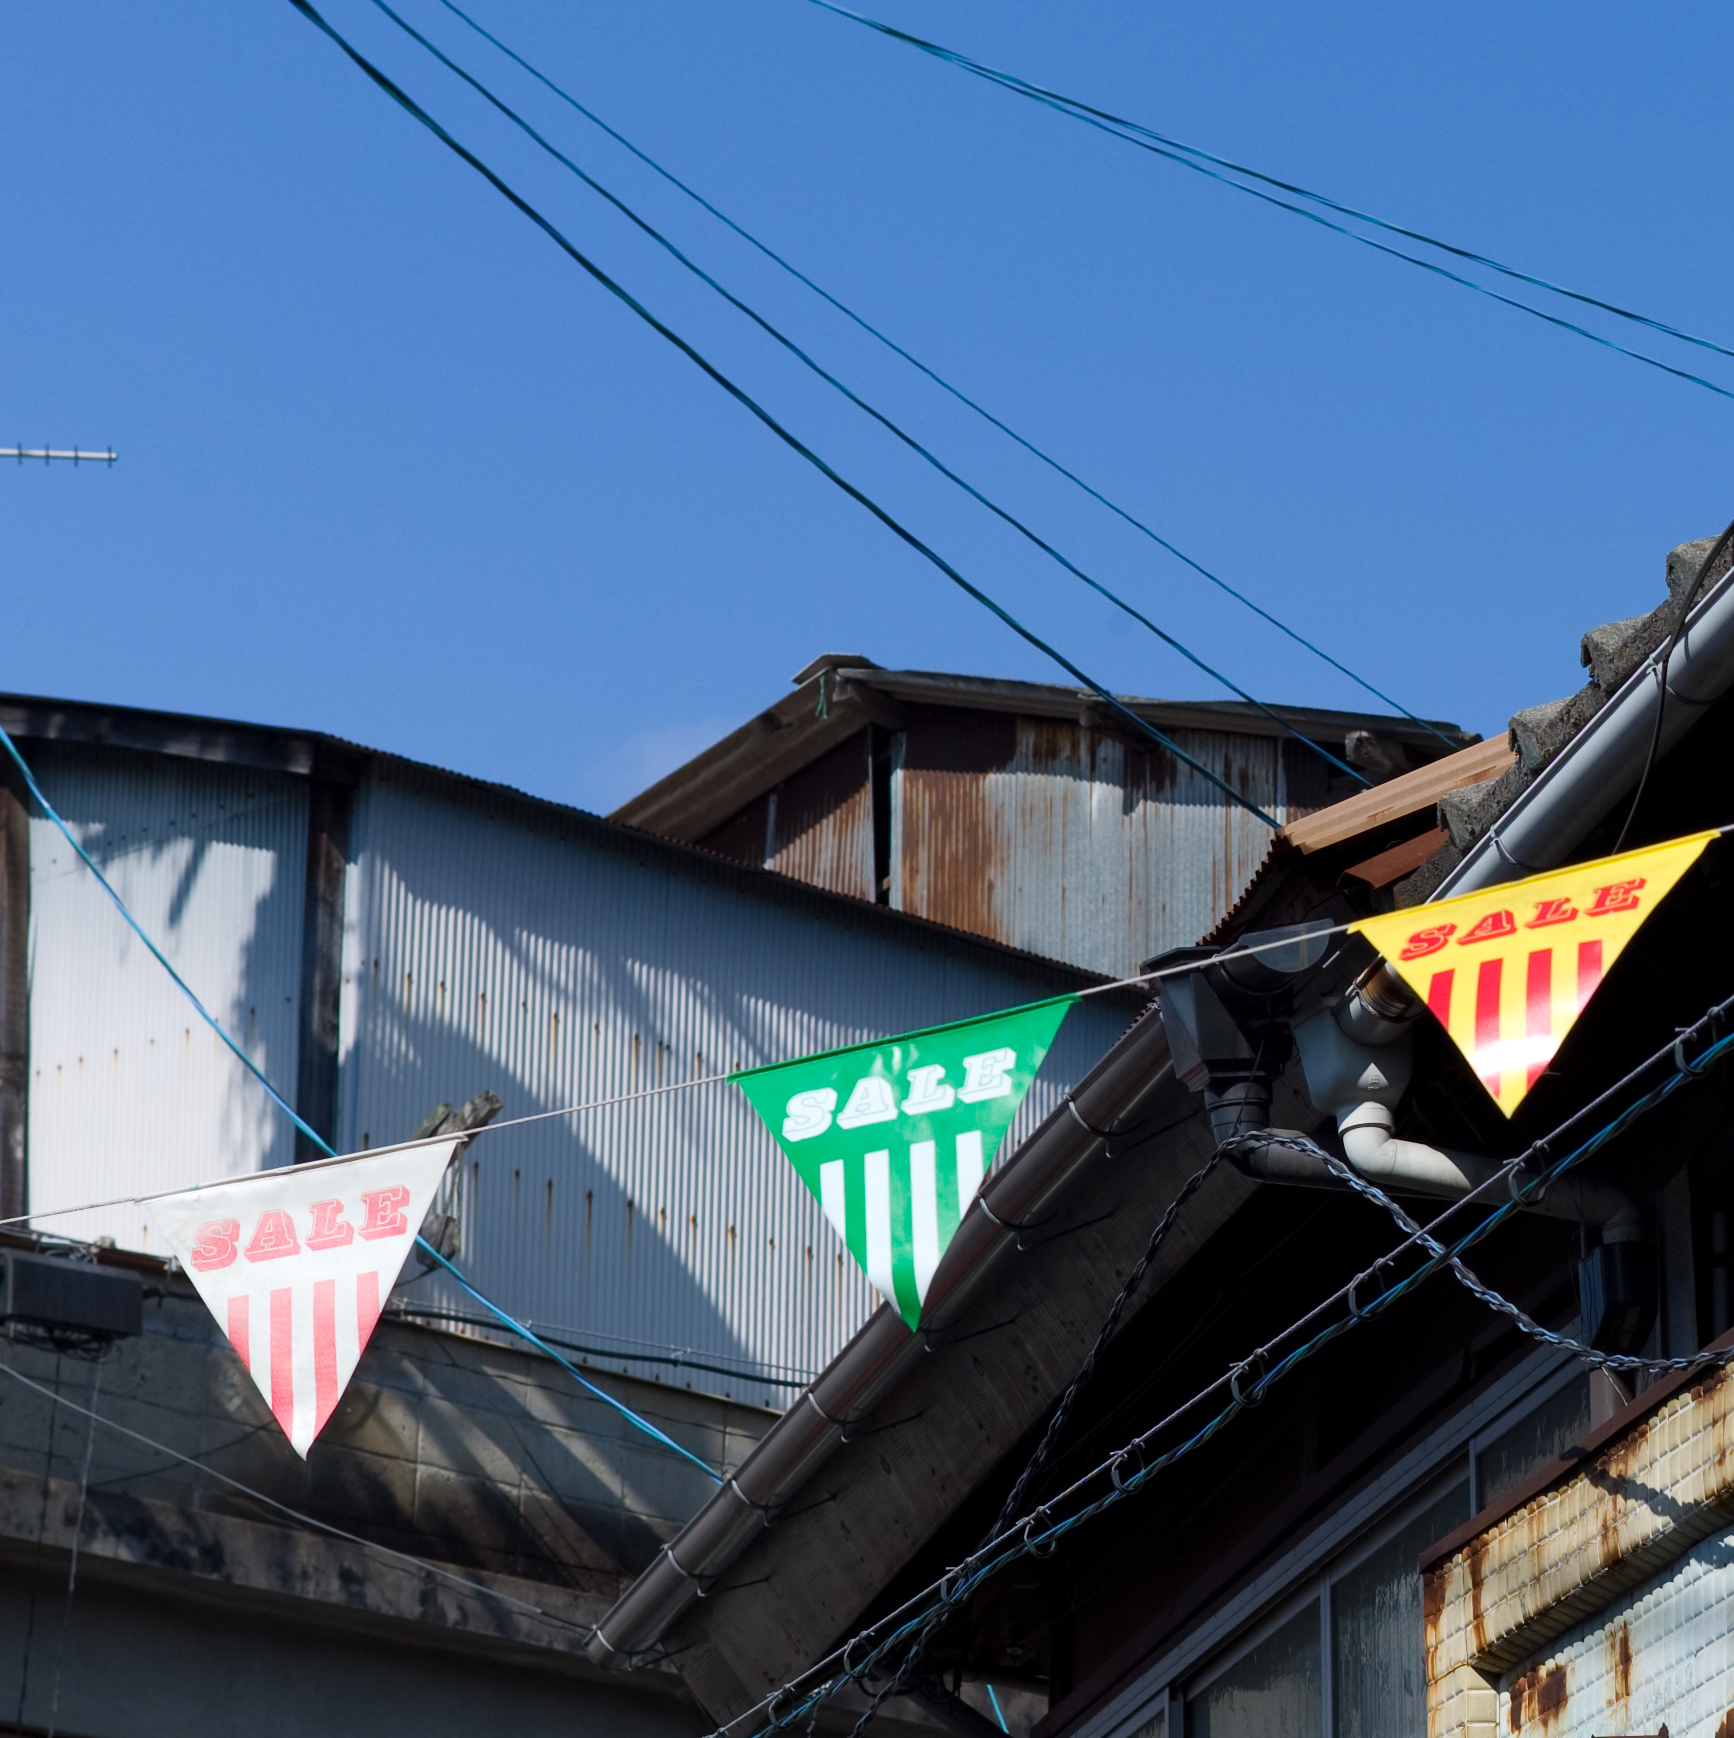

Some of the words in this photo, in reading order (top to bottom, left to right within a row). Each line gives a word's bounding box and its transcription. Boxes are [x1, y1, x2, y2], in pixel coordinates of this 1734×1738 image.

[1397, 875, 1648, 962] SALE
[781, 1045, 1018, 1143] SALE
[189, 1183, 412, 1273] SALE
